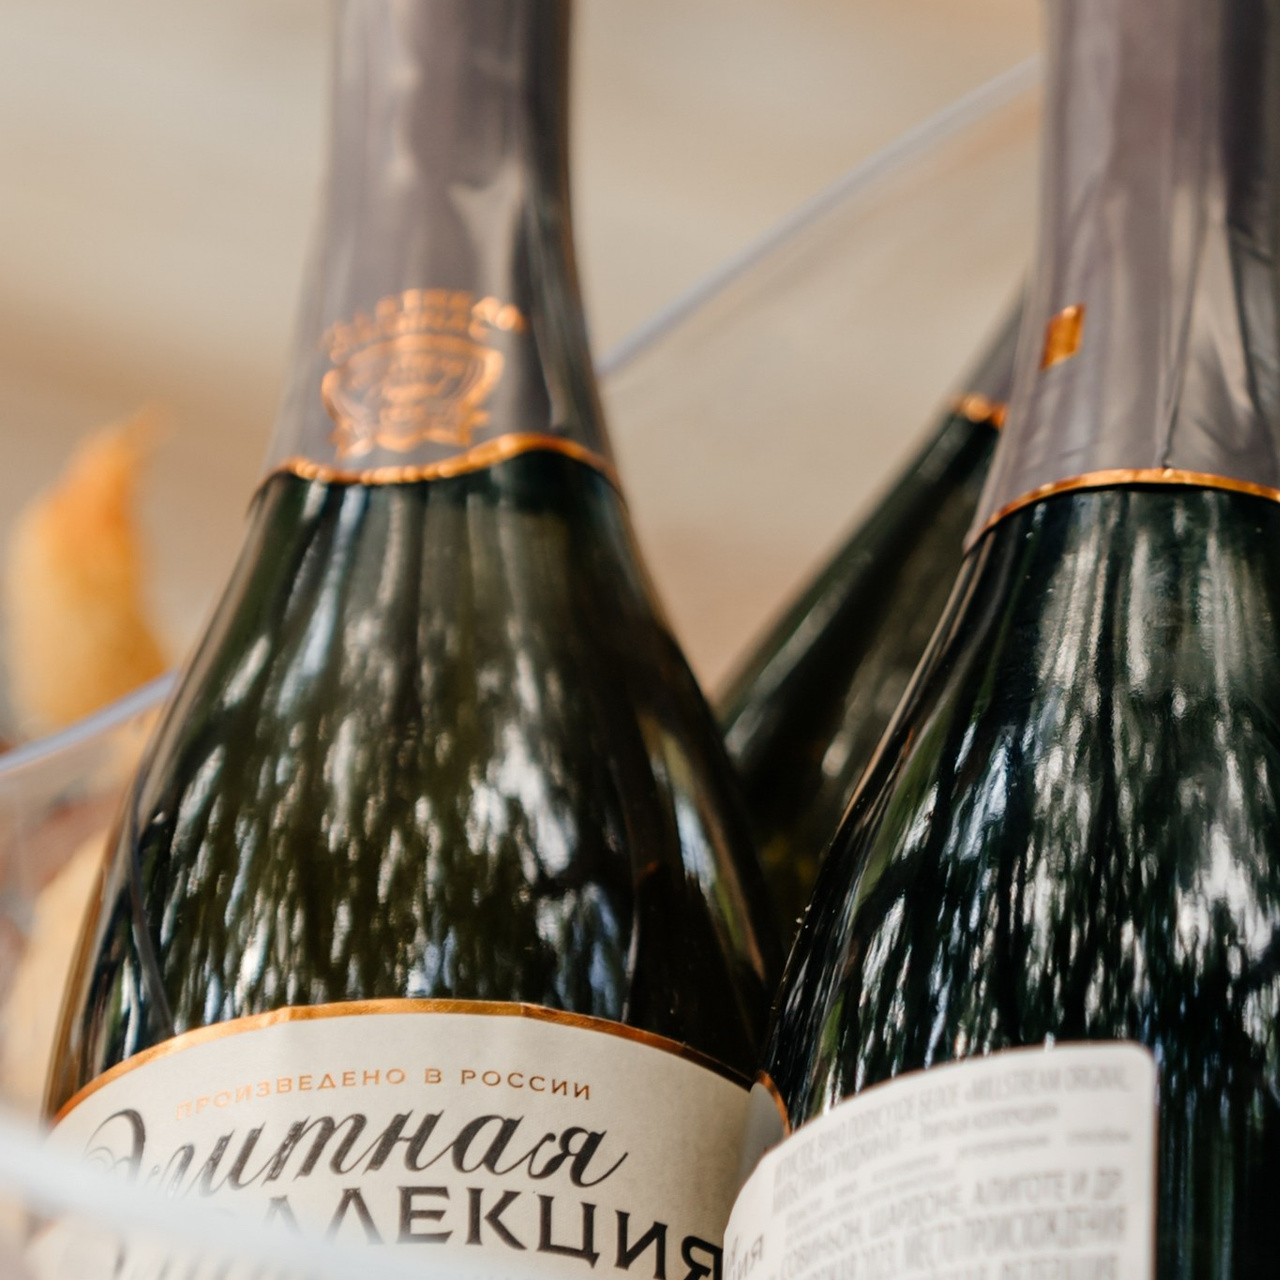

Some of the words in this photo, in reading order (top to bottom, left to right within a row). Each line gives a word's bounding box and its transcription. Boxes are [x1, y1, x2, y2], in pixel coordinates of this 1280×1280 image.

[175, 1067, 406, 1122] ПРОИЗВЕДЕНО
[424, 1067, 443, 1086] В
[460, 1068, 591, 1101] РОССИИ
